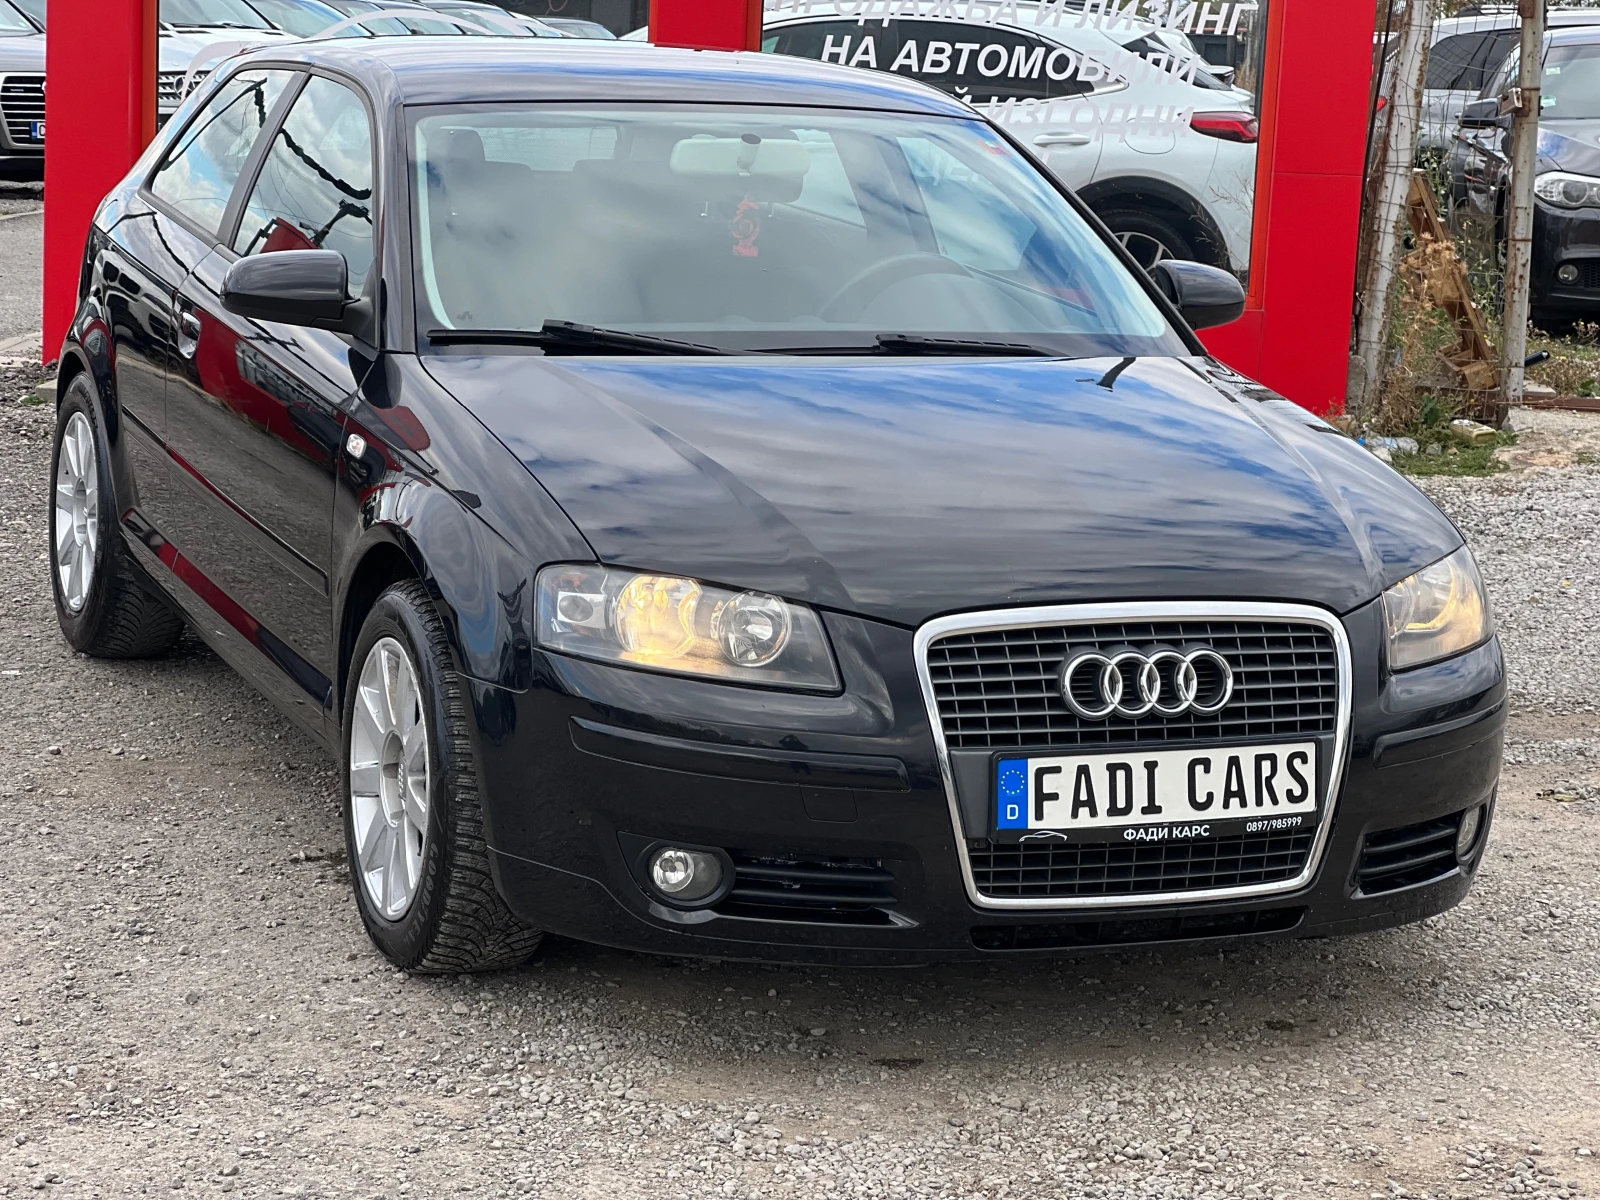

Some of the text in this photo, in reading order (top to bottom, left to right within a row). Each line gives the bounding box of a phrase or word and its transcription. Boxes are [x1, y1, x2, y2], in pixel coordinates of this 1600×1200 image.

[1034, 0, 1066, 27] И
[1074, 0, 1258, 36] ЛИЗИНГ
[821, 35, 1200, 86] НА АВТОМОБИЛИ
[988, 96, 1194, 143] ИЗГОДНИ
[1007, 751, 1309, 821] D FADI CARS
[1123, 816, 1302, 842] ФАДИ КАРС 0897/985999
